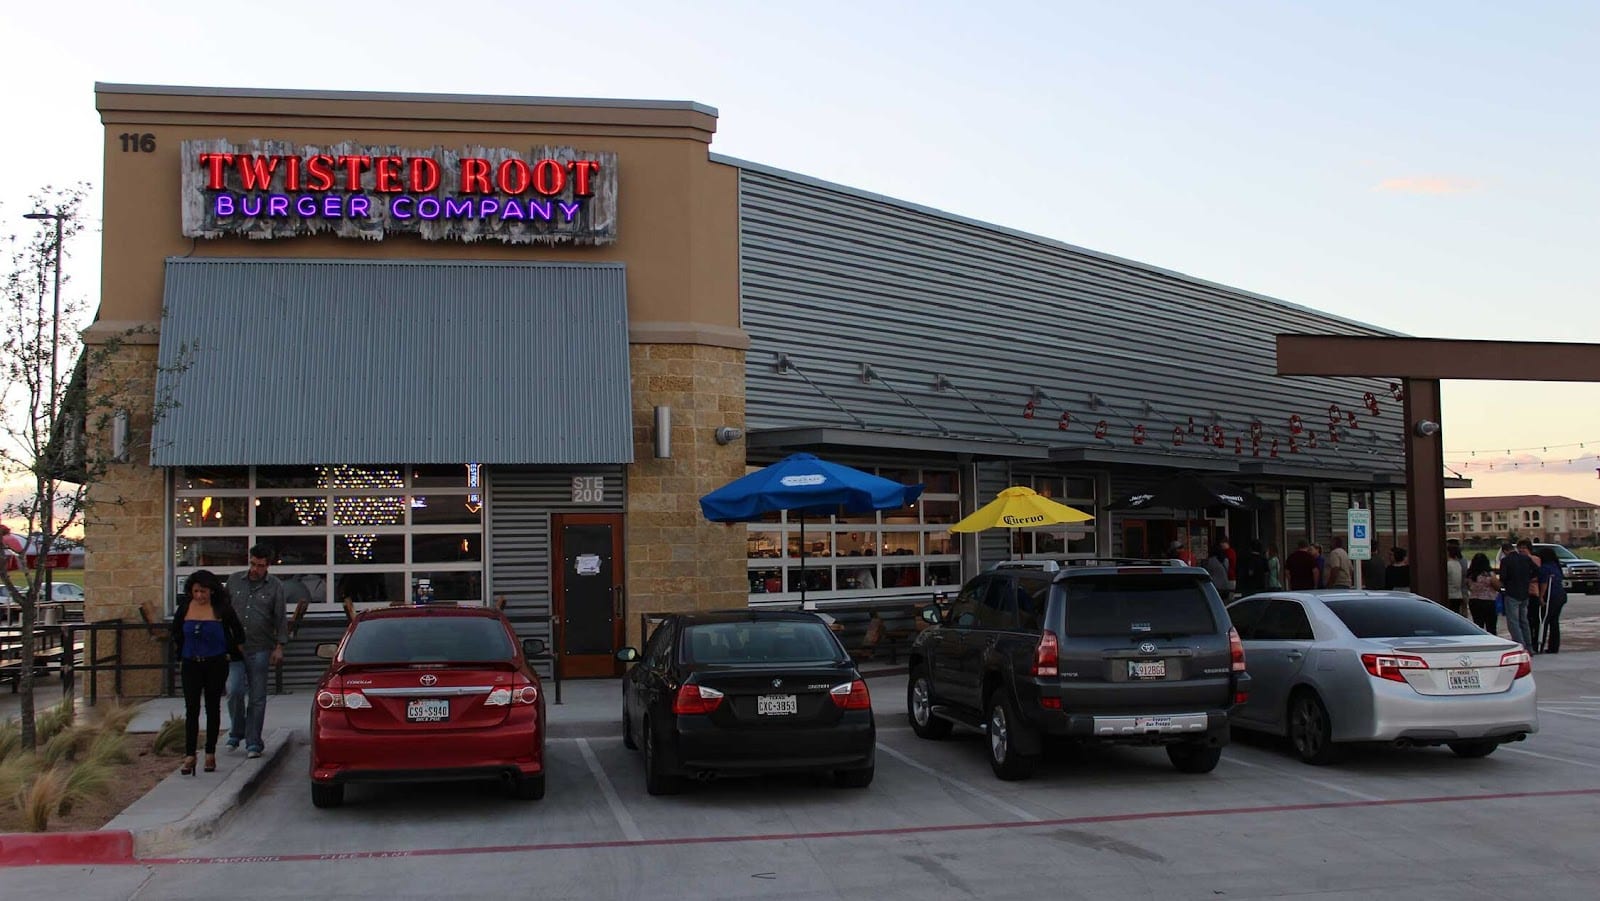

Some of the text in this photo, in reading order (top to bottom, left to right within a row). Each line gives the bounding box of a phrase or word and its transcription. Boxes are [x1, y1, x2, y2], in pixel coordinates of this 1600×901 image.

[119, 133, 157, 152] 116
[199, 153, 599, 197] TWISTED ROOT
[215, 195, 581, 222] BURGER COMPANY
[574, 476, 604, 489] STE
[574, 489, 603, 503] 200
[1003, 514, 1045, 526] Cuervo
